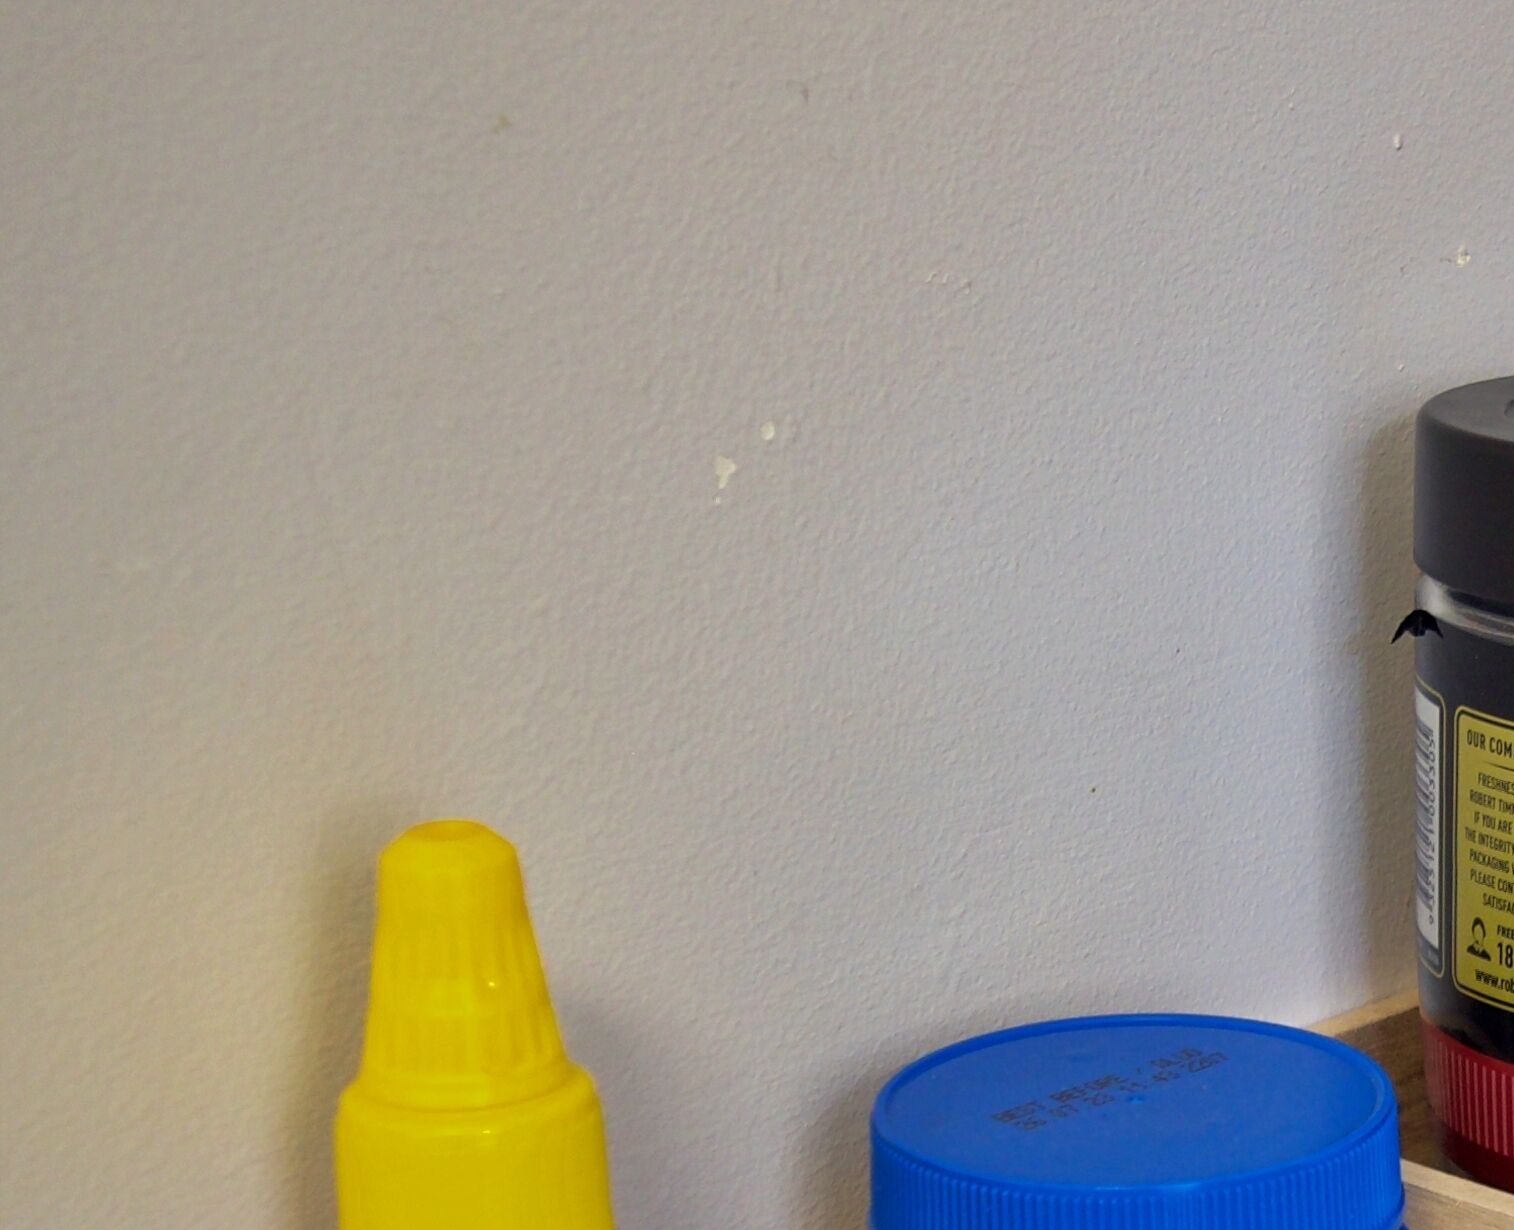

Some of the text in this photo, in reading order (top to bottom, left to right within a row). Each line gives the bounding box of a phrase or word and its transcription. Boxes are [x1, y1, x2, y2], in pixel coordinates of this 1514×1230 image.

[1466, 729, 1486, 750] OUR
[1469, 789, 1496, 808] ROBERT
[1473, 811, 1480, 823] IF
[1482, 814, 1496, 830] YOU
[1497, 820, 1512, 834] ARE
[1464, 826, 1477, 842] THE
[1469, 848, 1510, 874] PACKAGING
[1470, 868, 1496, 889] PLEASE
